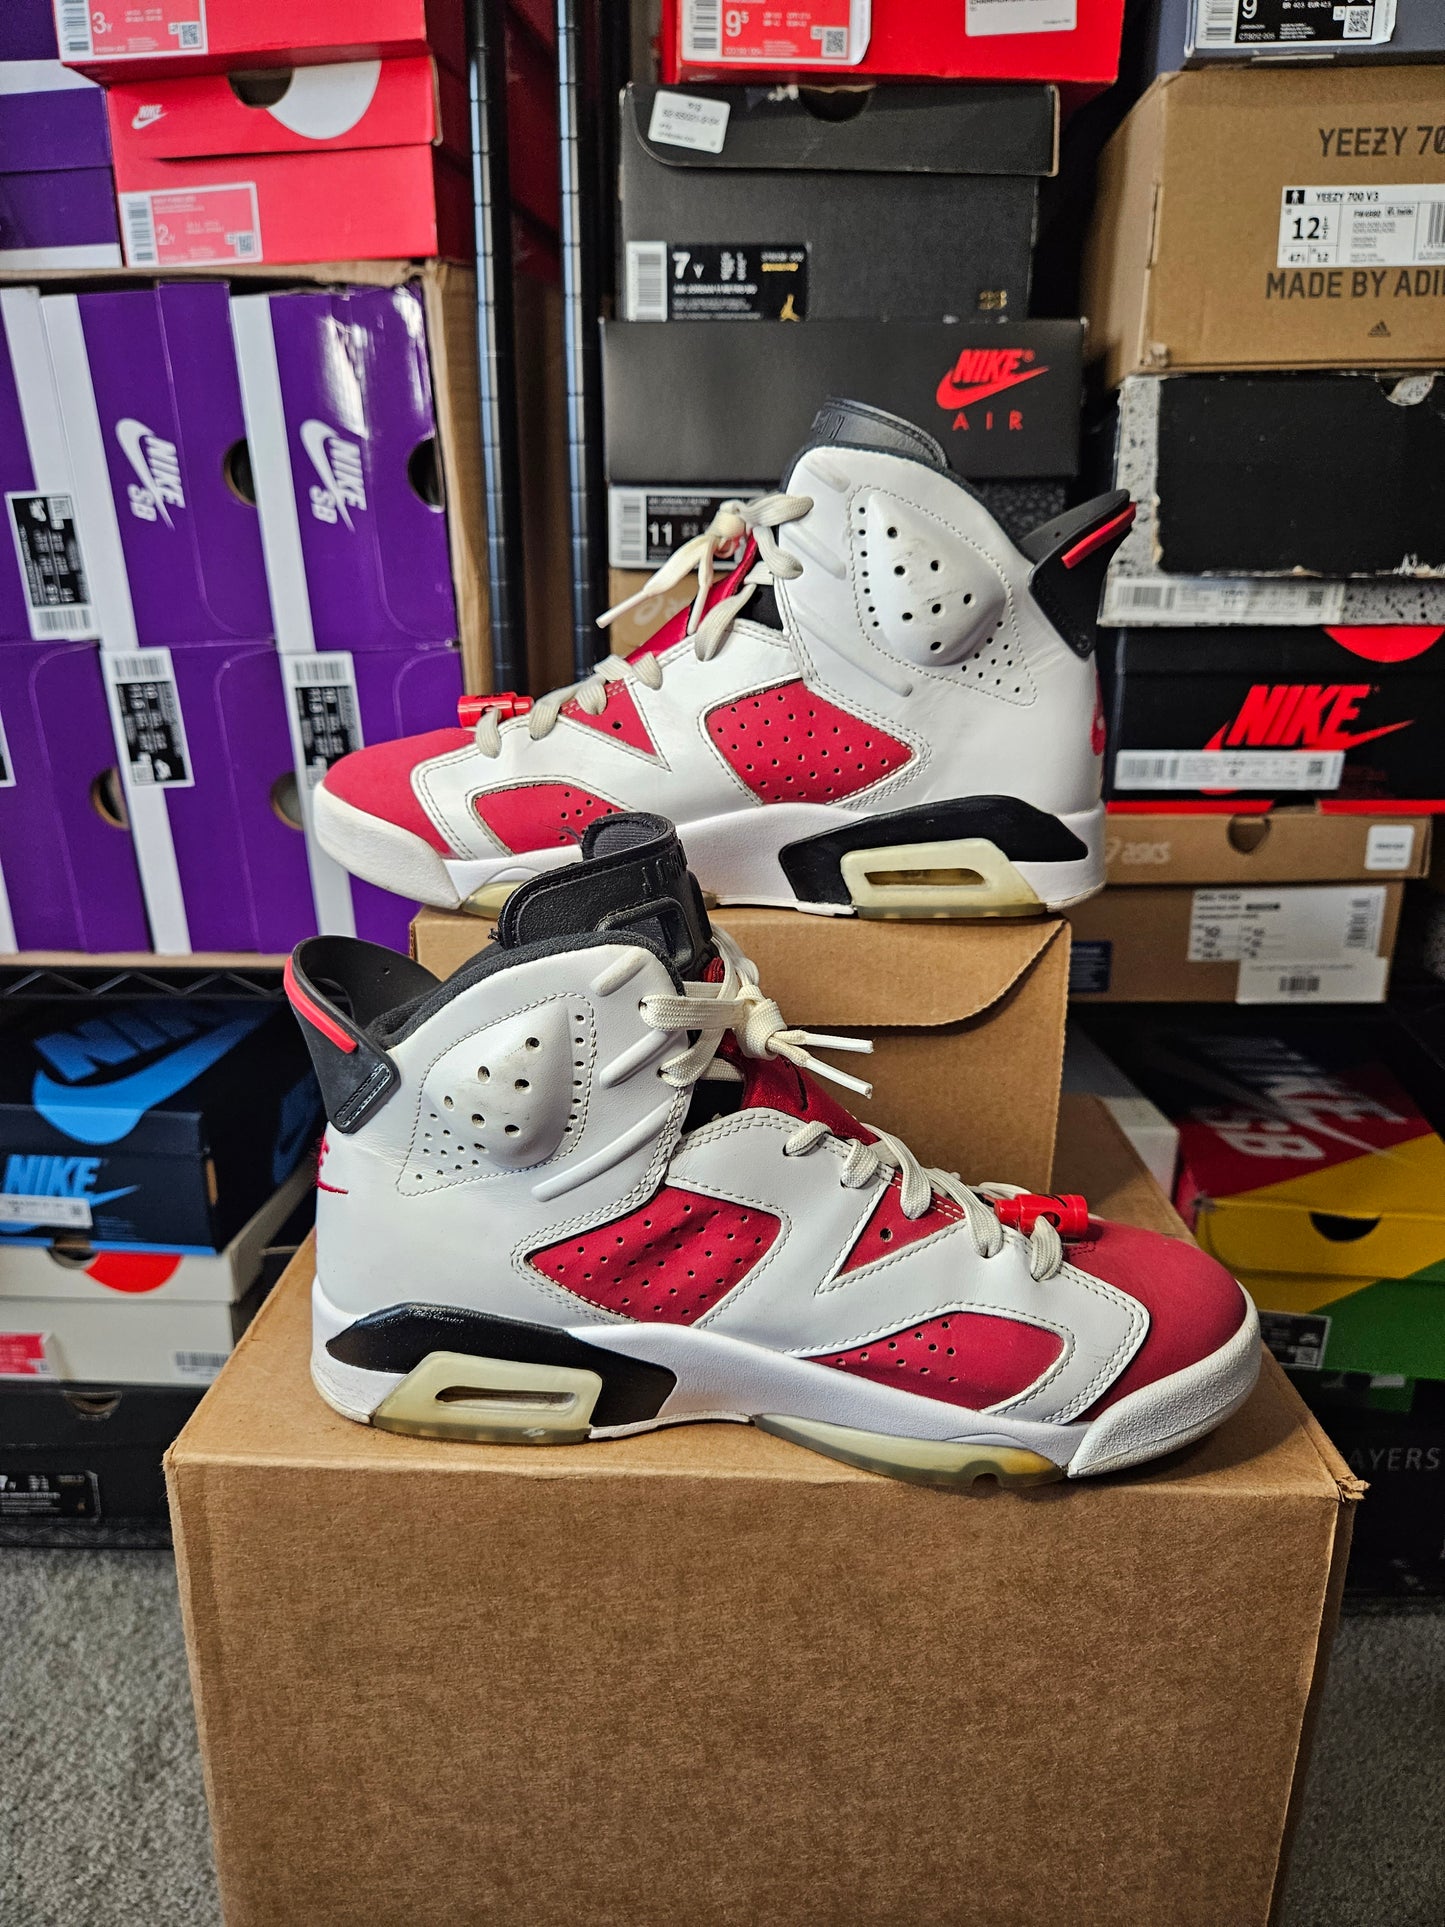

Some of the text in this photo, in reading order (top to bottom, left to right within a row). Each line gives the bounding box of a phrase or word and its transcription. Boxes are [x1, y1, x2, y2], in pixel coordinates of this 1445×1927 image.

[139, 104, 163, 117] NIKE
[1319, 127, 1407, 157] YEEZY
[1316, 191, 1343, 202] YEEZY
[1347, 191, 1364, 202] 700
[1292, 217, 1320, 240] 12
[1266, 273, 1343, 299] MADE
[1352, 272, 1387, 297] BY
[952, 348, 1023, 382] NIKE
[952, 410, 1024, 431] AIR
[144, 435, 186, 509] NIKE
[328, 435, 367, 511] NIKE
[128, 484, 156, 522] SB
[309, 486, 337, 524] SB
[648, 521, 673, 546] 11
[1226, 684, 1371, 747] NIKE
[3, 1154, 103, 1197] NIKE
